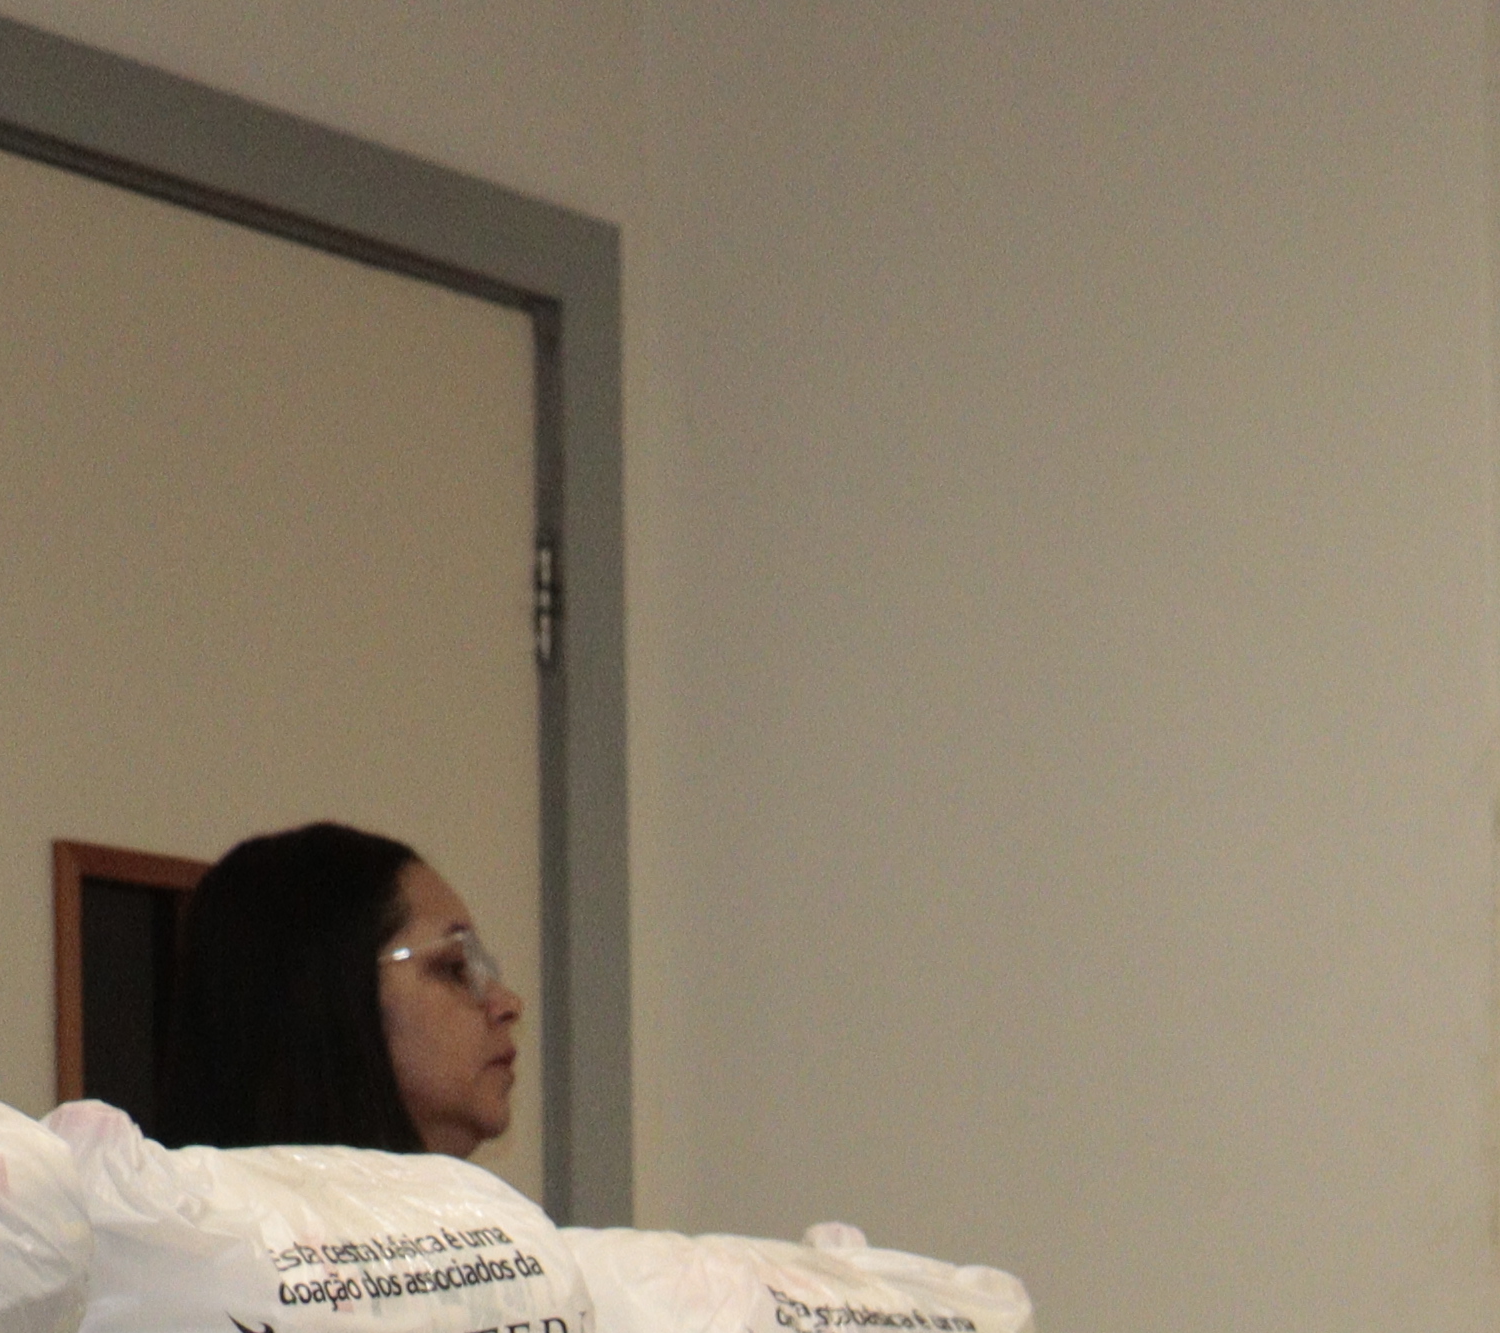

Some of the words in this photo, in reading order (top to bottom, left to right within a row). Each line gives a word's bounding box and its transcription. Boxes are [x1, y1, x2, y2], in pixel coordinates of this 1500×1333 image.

[363, 1271, 402, 1298] dos
[405, 1255, 515, 1294] associados
[516, 1250, 544, 1277] da
